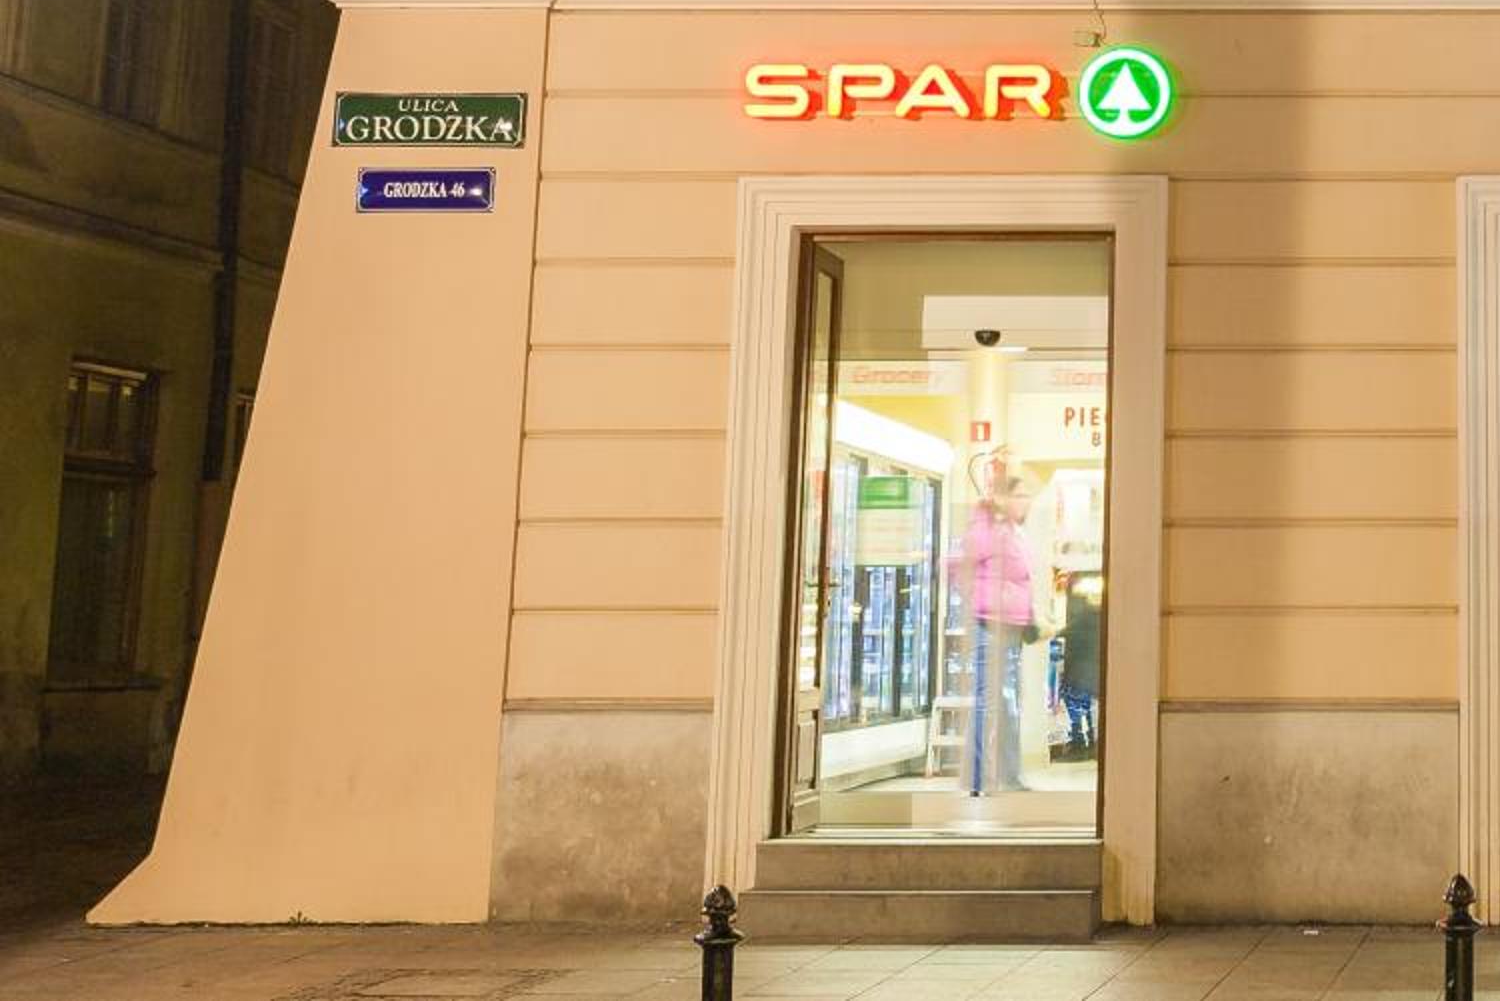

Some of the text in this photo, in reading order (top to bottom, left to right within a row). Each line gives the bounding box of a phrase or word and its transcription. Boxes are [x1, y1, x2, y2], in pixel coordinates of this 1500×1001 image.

[744, 64, 1054, 119] SPAR
[399, 99, 459, 112] ULICA
[346, 115, 513, 141] GRODZKA
[384, 183, 465, 198] GRODZKA 46
